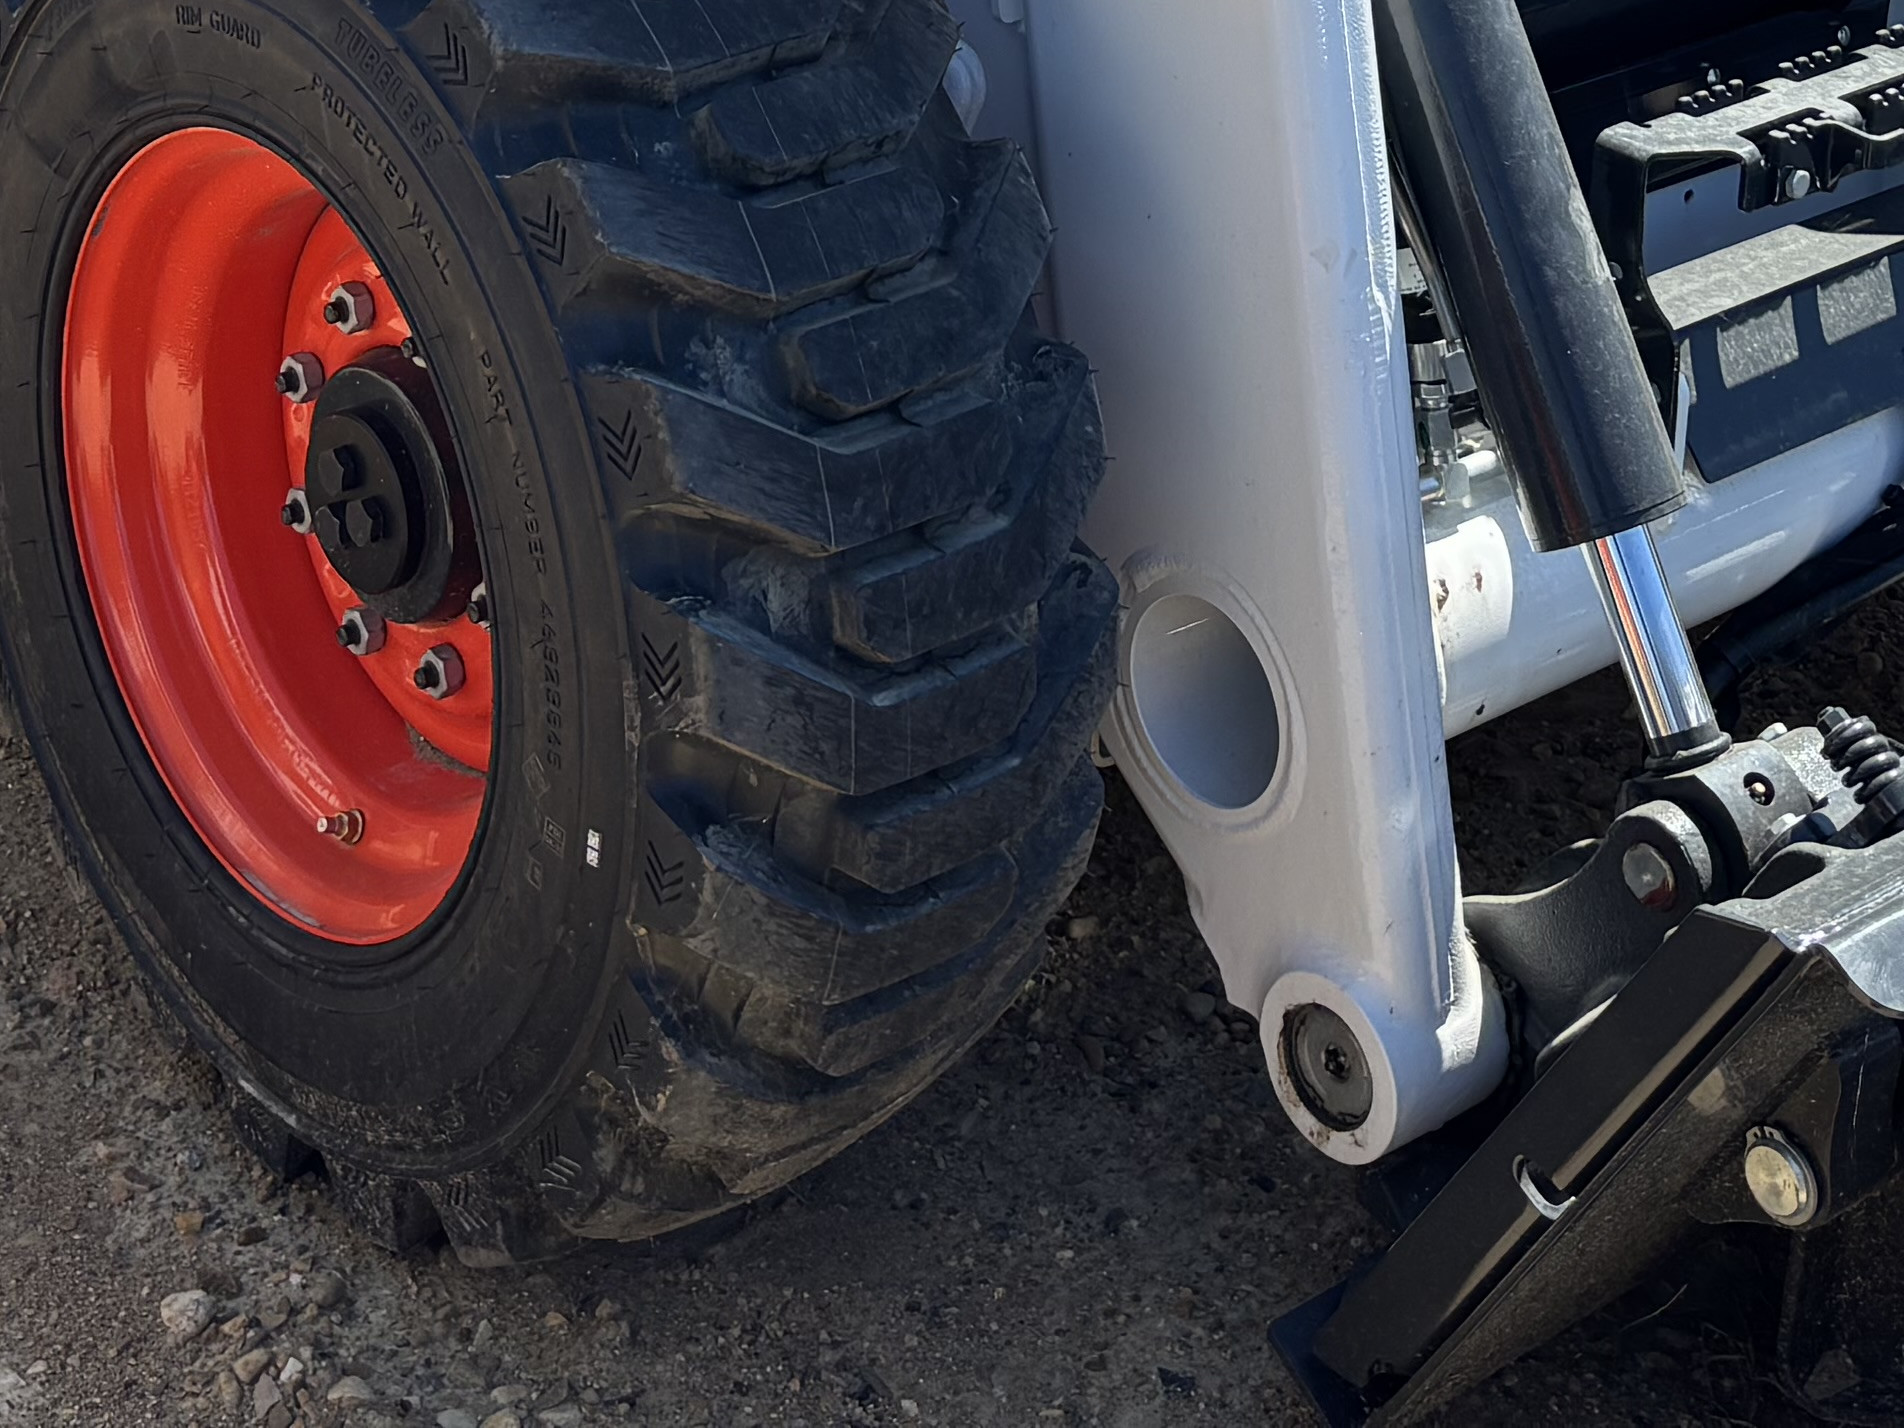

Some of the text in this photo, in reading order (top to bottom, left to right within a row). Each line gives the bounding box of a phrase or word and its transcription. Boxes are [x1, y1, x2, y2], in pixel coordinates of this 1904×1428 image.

[175, 3, 262, 50] RIM GUARD
[335, 17, 444, 157] TUBELESS
[309, 72, 450, 287] PROTECTED WALL
[478, 350, 513, 427] PART
[512, 450, 547, 576] NUMBER
